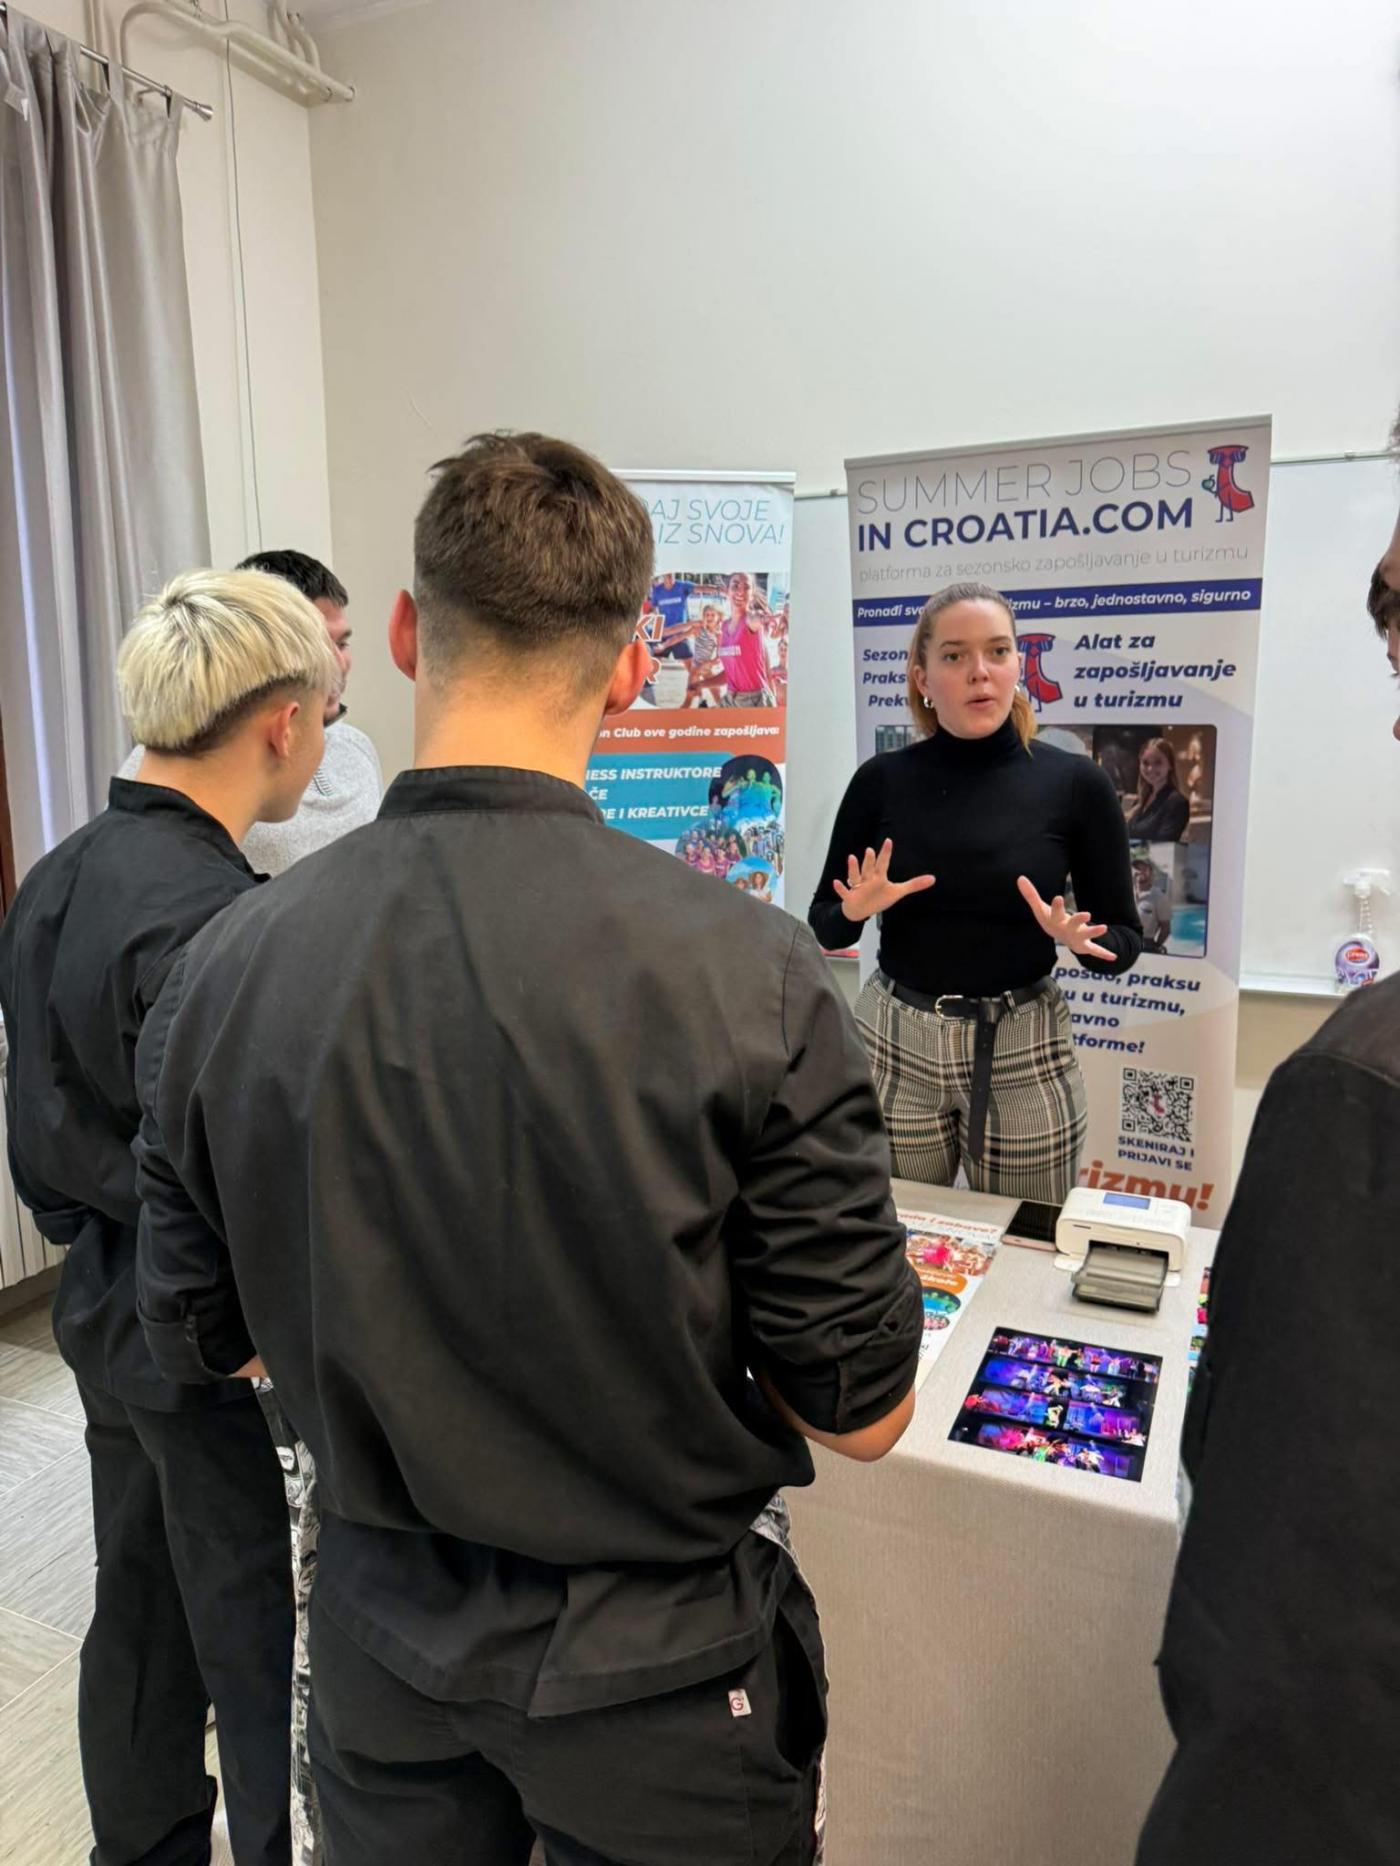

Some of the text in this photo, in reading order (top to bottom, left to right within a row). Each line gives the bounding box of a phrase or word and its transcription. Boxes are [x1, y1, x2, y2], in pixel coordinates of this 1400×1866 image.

[858, 449, 1191, 515] SUMMER JOBS
[688, 499, 770, 522] SVOJE
[658, 523, 785, 545] IZ SNOVA!
[858, 497, 1193, 552] IN CROATIA.COM
[859, 545, 1249, 583] platforma za sezonsko zapošljavanje u turizmu
[857, 604, 903, 618] Pronađi
[1054, 596, 1090, 609] brzo,
[1091, 591, 1188, 610] jednostavno,
[1191, 589, 1251, 605] sigurno
[1073, 634, 1156, 650] Alat za
[863, 648, 908, 661] Sezon
[863, 670, 907, 684] Praks
[1073, 658, 1237, 682] zapošljavanje
[1073, 690, 1183, 708] u turizmu
[613, 727, 641, 738] Club
[643, 728, 666, 737] ove
[668, 725, 711, 740] godine
[714, 724, 780, 740] zapošljava:
[620, 766, 723, 780] INSTRUKTORE
[619, 808, 625, 819] I
[627, 805, 709, 819] KREATIVCE
[1127, 973, 1201, 992] praksu
[1082, 992, 1095, 1003] u
[1100, 991, 1186, 1016] turizmu,
[1118, 1136, 1195, 1158] SKENIRAJ I
[1118, 1149, 1193, 1171] PRIJAVI SE
